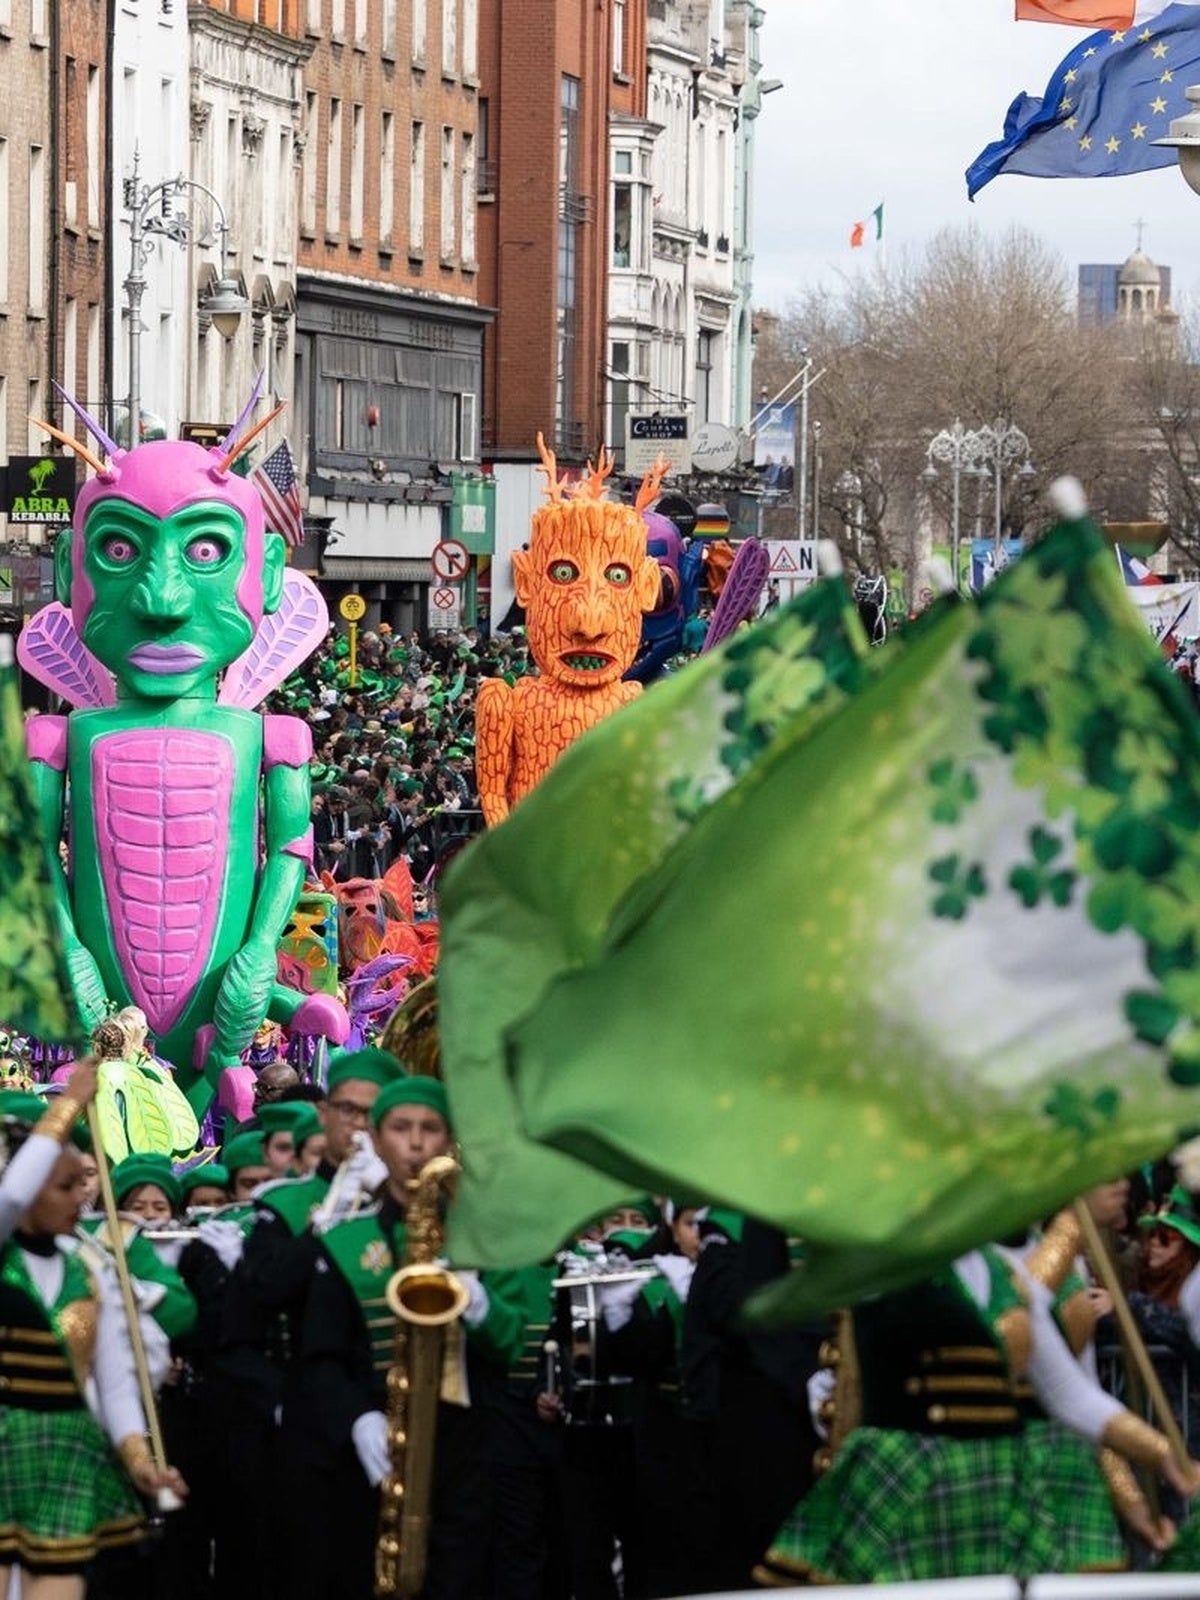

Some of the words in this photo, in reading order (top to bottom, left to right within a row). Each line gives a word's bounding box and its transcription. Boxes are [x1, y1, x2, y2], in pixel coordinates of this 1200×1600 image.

[634, 420, 684, 434] COMPANY
[11, 497, 71, 512] ABRA
[11, 512, 71, 522] KEBABRA
[800, 547, 812, 570] N
